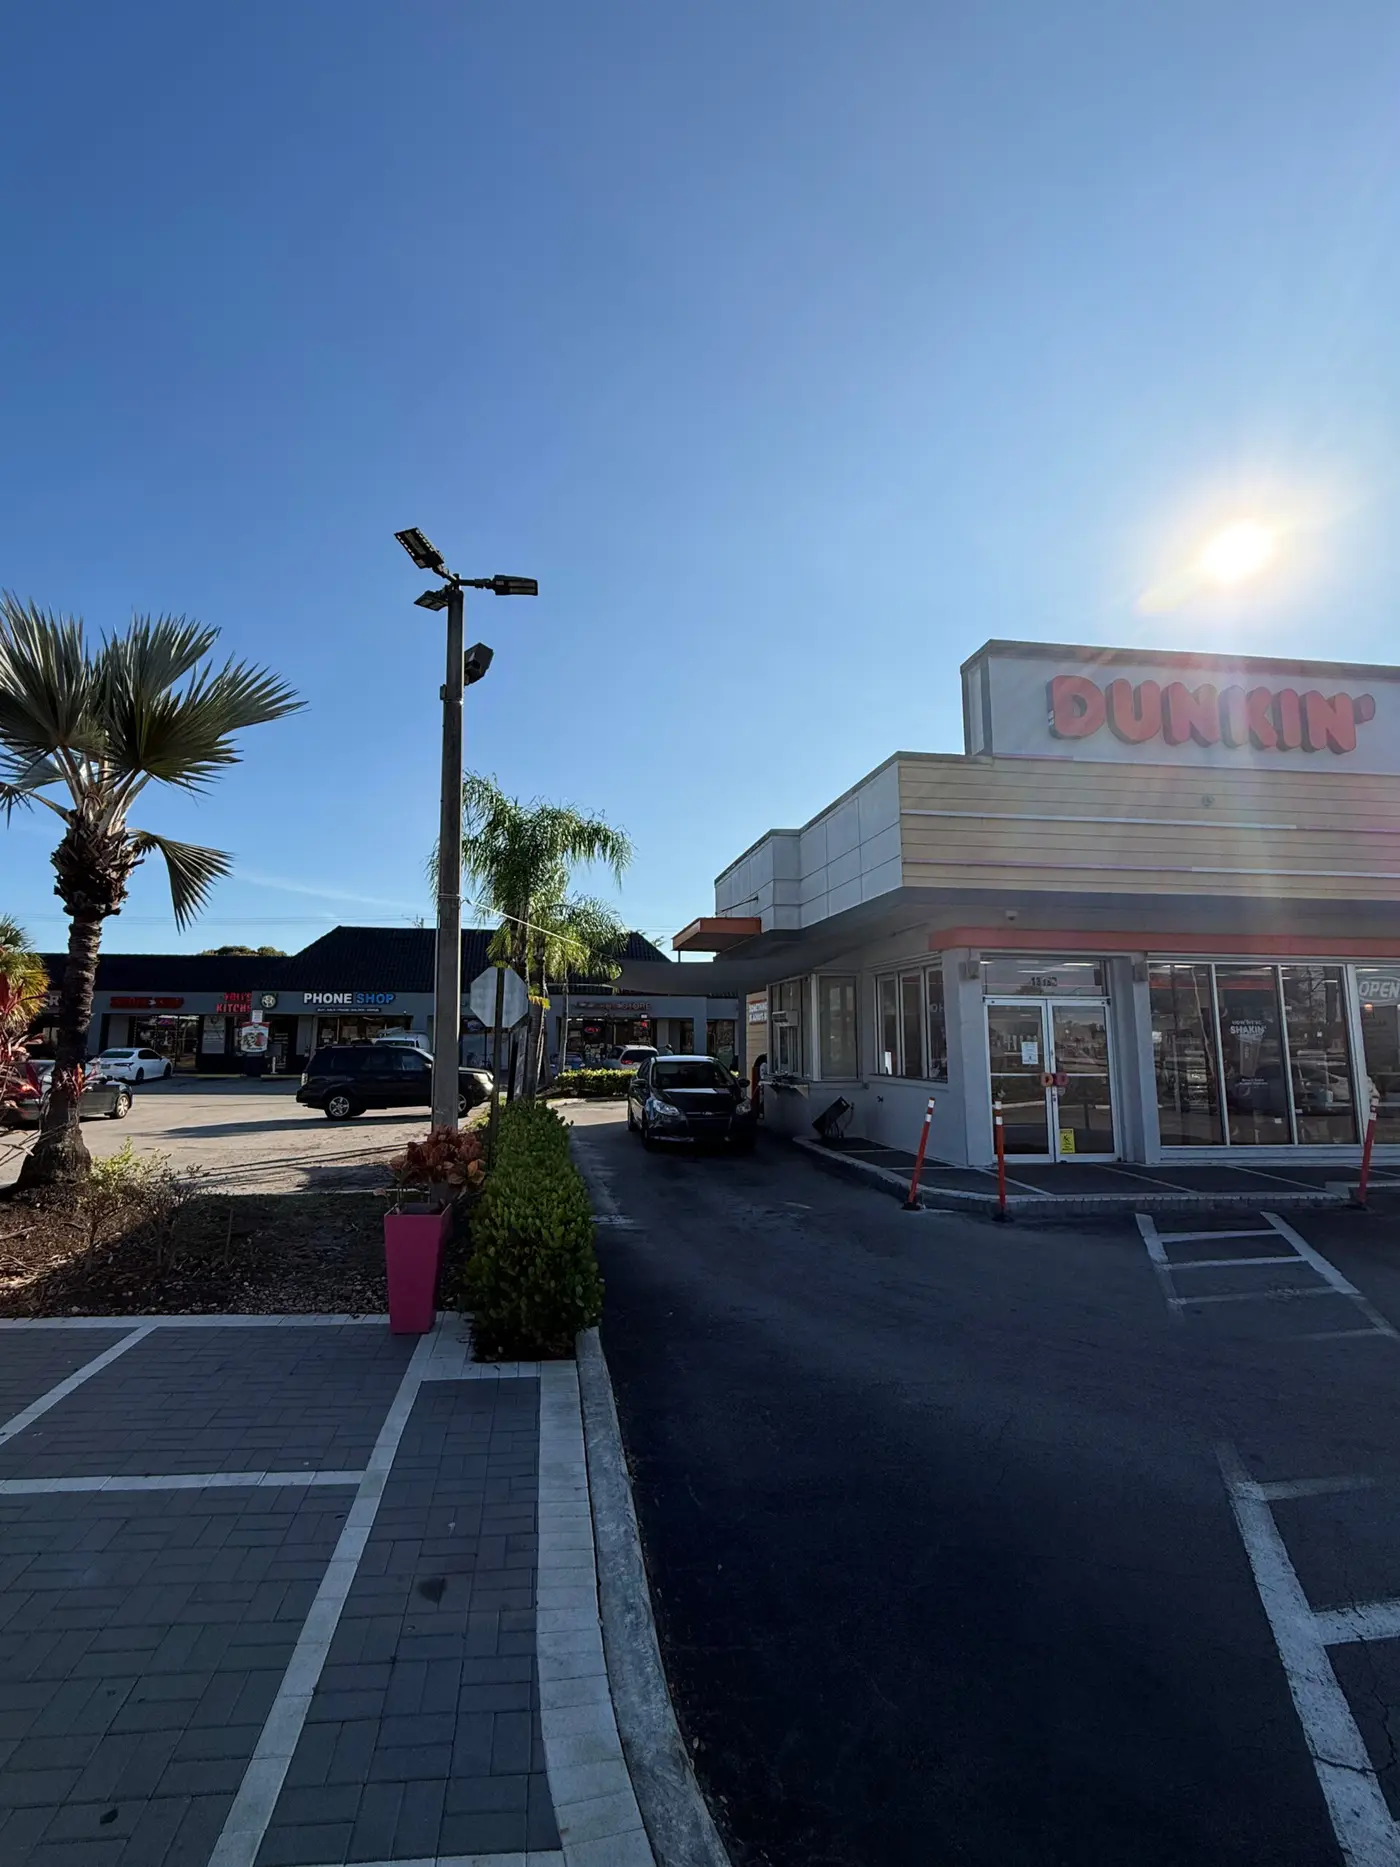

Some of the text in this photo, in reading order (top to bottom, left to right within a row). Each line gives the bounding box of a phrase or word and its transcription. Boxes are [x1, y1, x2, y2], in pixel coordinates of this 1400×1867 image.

[1046, 674, 1376, 754] DUNKIN'
[303, 992, 395, 1004] PHONE SHOP
[1359, 981, 1400, 998] OPEN
